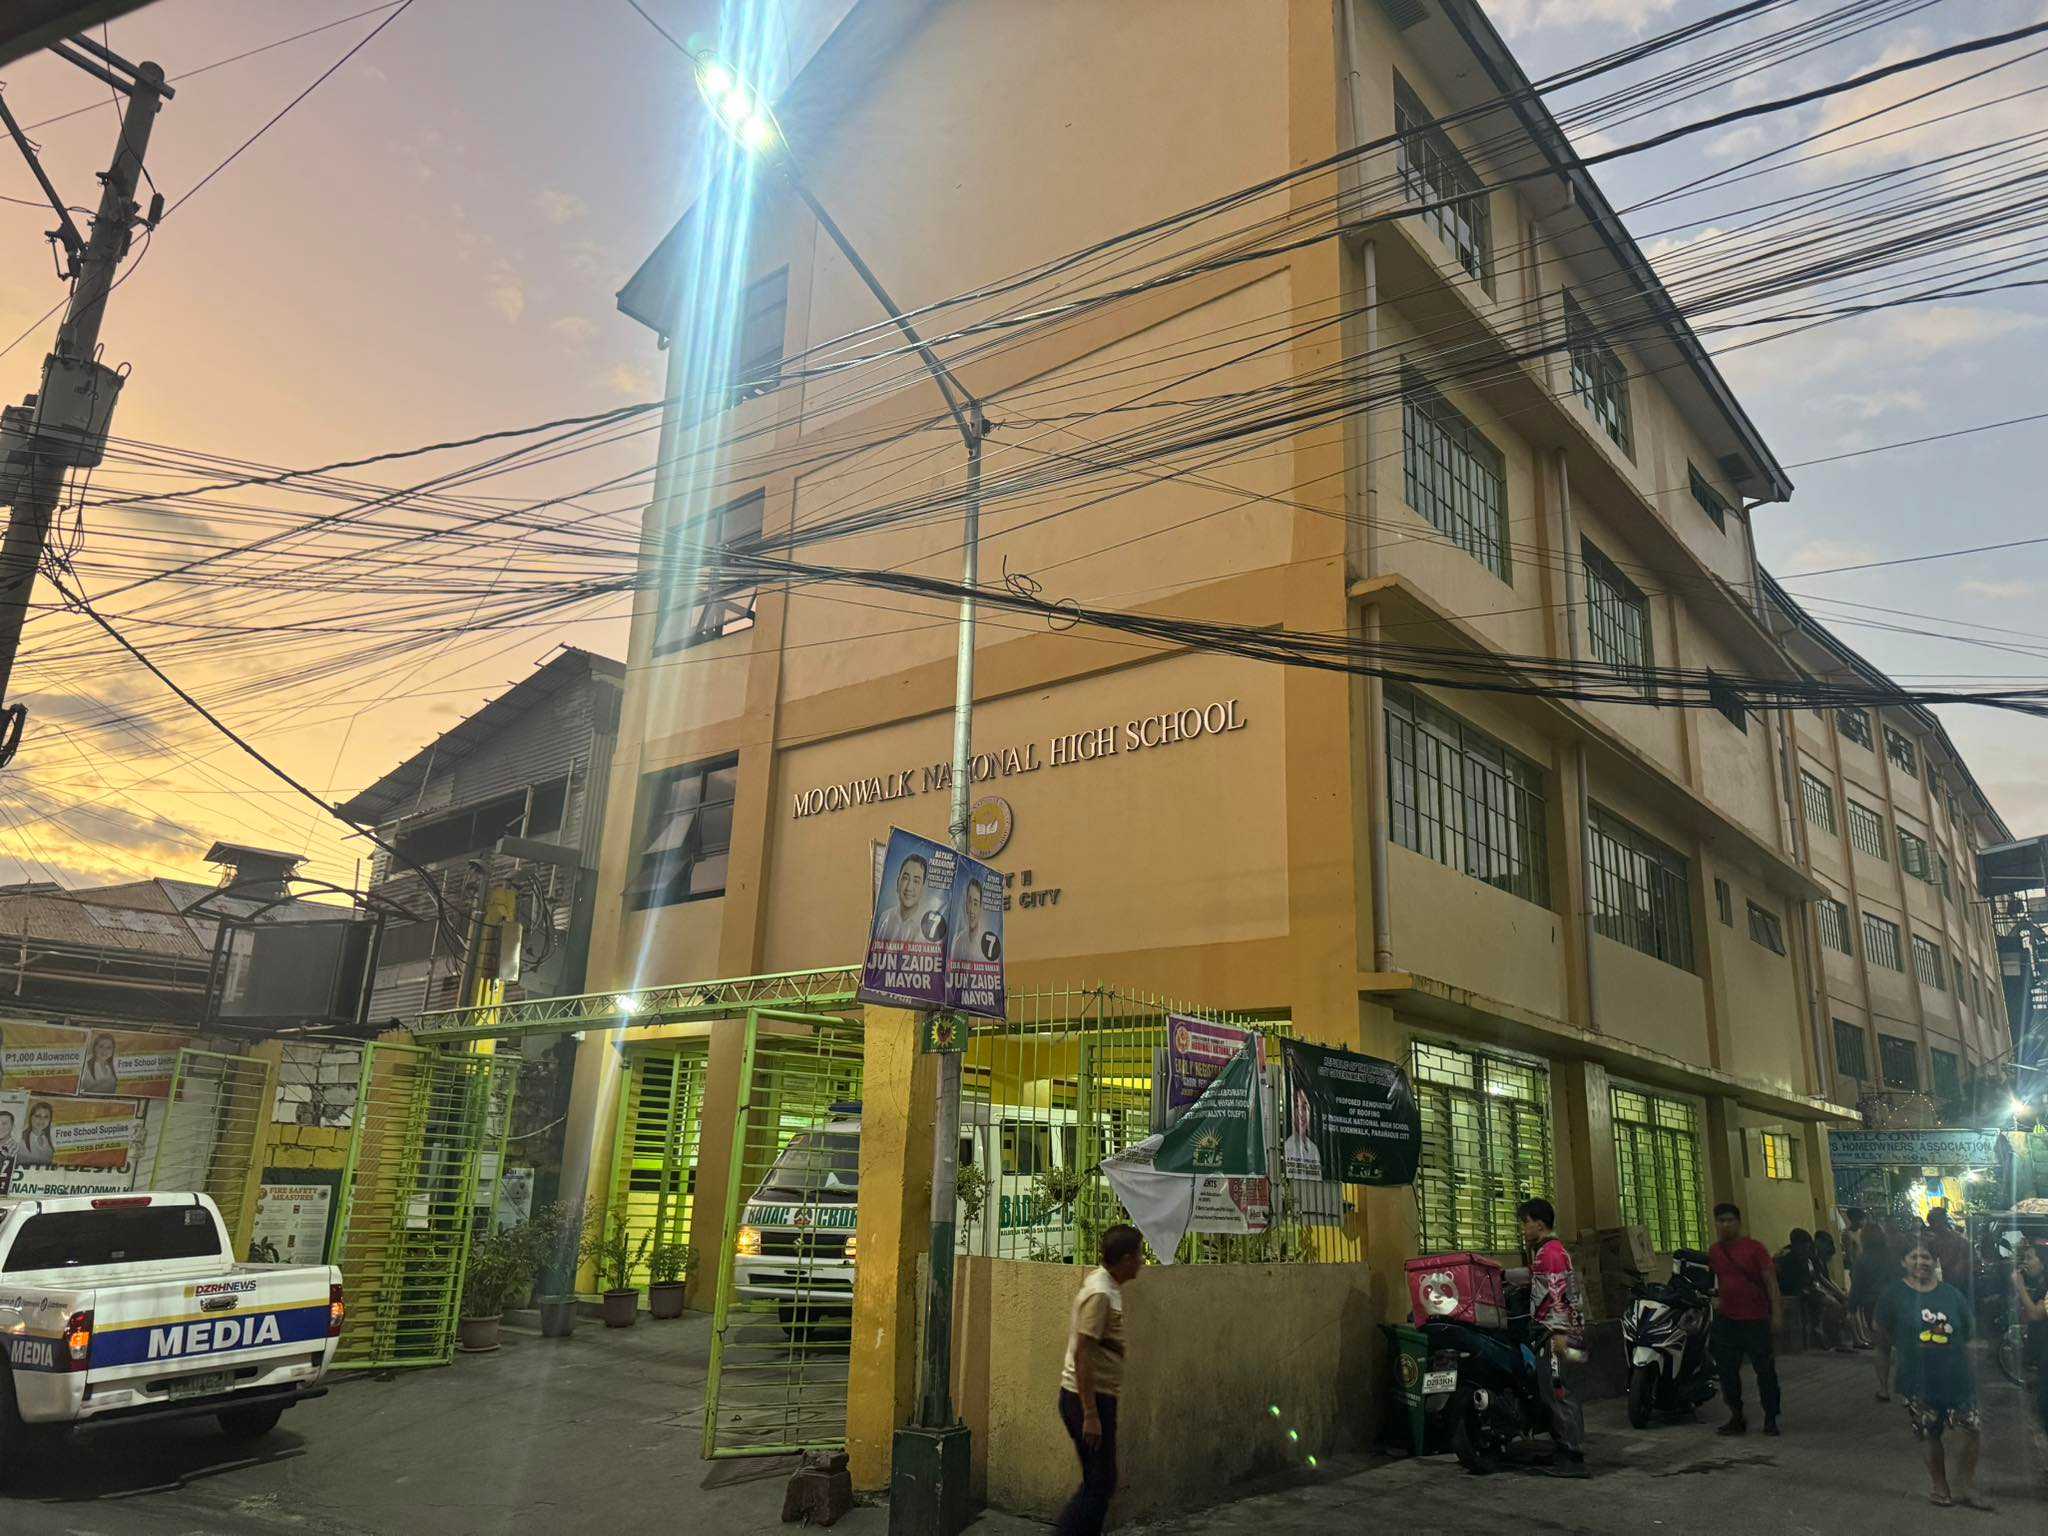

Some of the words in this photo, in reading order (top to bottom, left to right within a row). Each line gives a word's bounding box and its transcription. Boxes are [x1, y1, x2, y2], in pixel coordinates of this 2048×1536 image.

[793, 769, 914, 818] MOONWALK
[922, 744, 1041, 792] NAIONAL
[1050, 726, 1117, 767] HIGH
[1126, 699, 1247, 751] SCHOOL
[1019, 888, 1061, 908] CITY
[928, 913, 941, 940] 7
[986, 934, 997, 959] 7
[867, 952, 897, 970] JUN
[901, 955, 943, 973] ZAIDE
[885, 972, 932, 990] MAYOR
[946, 972, 968, 989] JUN
[970, 973, 1001, 990] ZAIDE
[961, 989, 995, 1006] MAYOR
[36, 1051, 80, 1062] Allowance
[118, 1060, 133, 1068] Free
[135, 1058, 156, 1068] School
[55, 1129, 71, 1138] Free
[73, 1127, 97, 1137] School
[99, 1124, 128, 1135] Supplies
[1834, 1132, 1928, 1142] WELCOME
[1842, 1142, 1913, 1152] HOMEOWNERS
[1919, 1141, 1992, 1153] ASSOCIATION
[747, 1206, 791, 1224] BADAC
[147, 1314, 281, 1359] MEDIA
[11, 1340, 53, 1367] MEDIA
